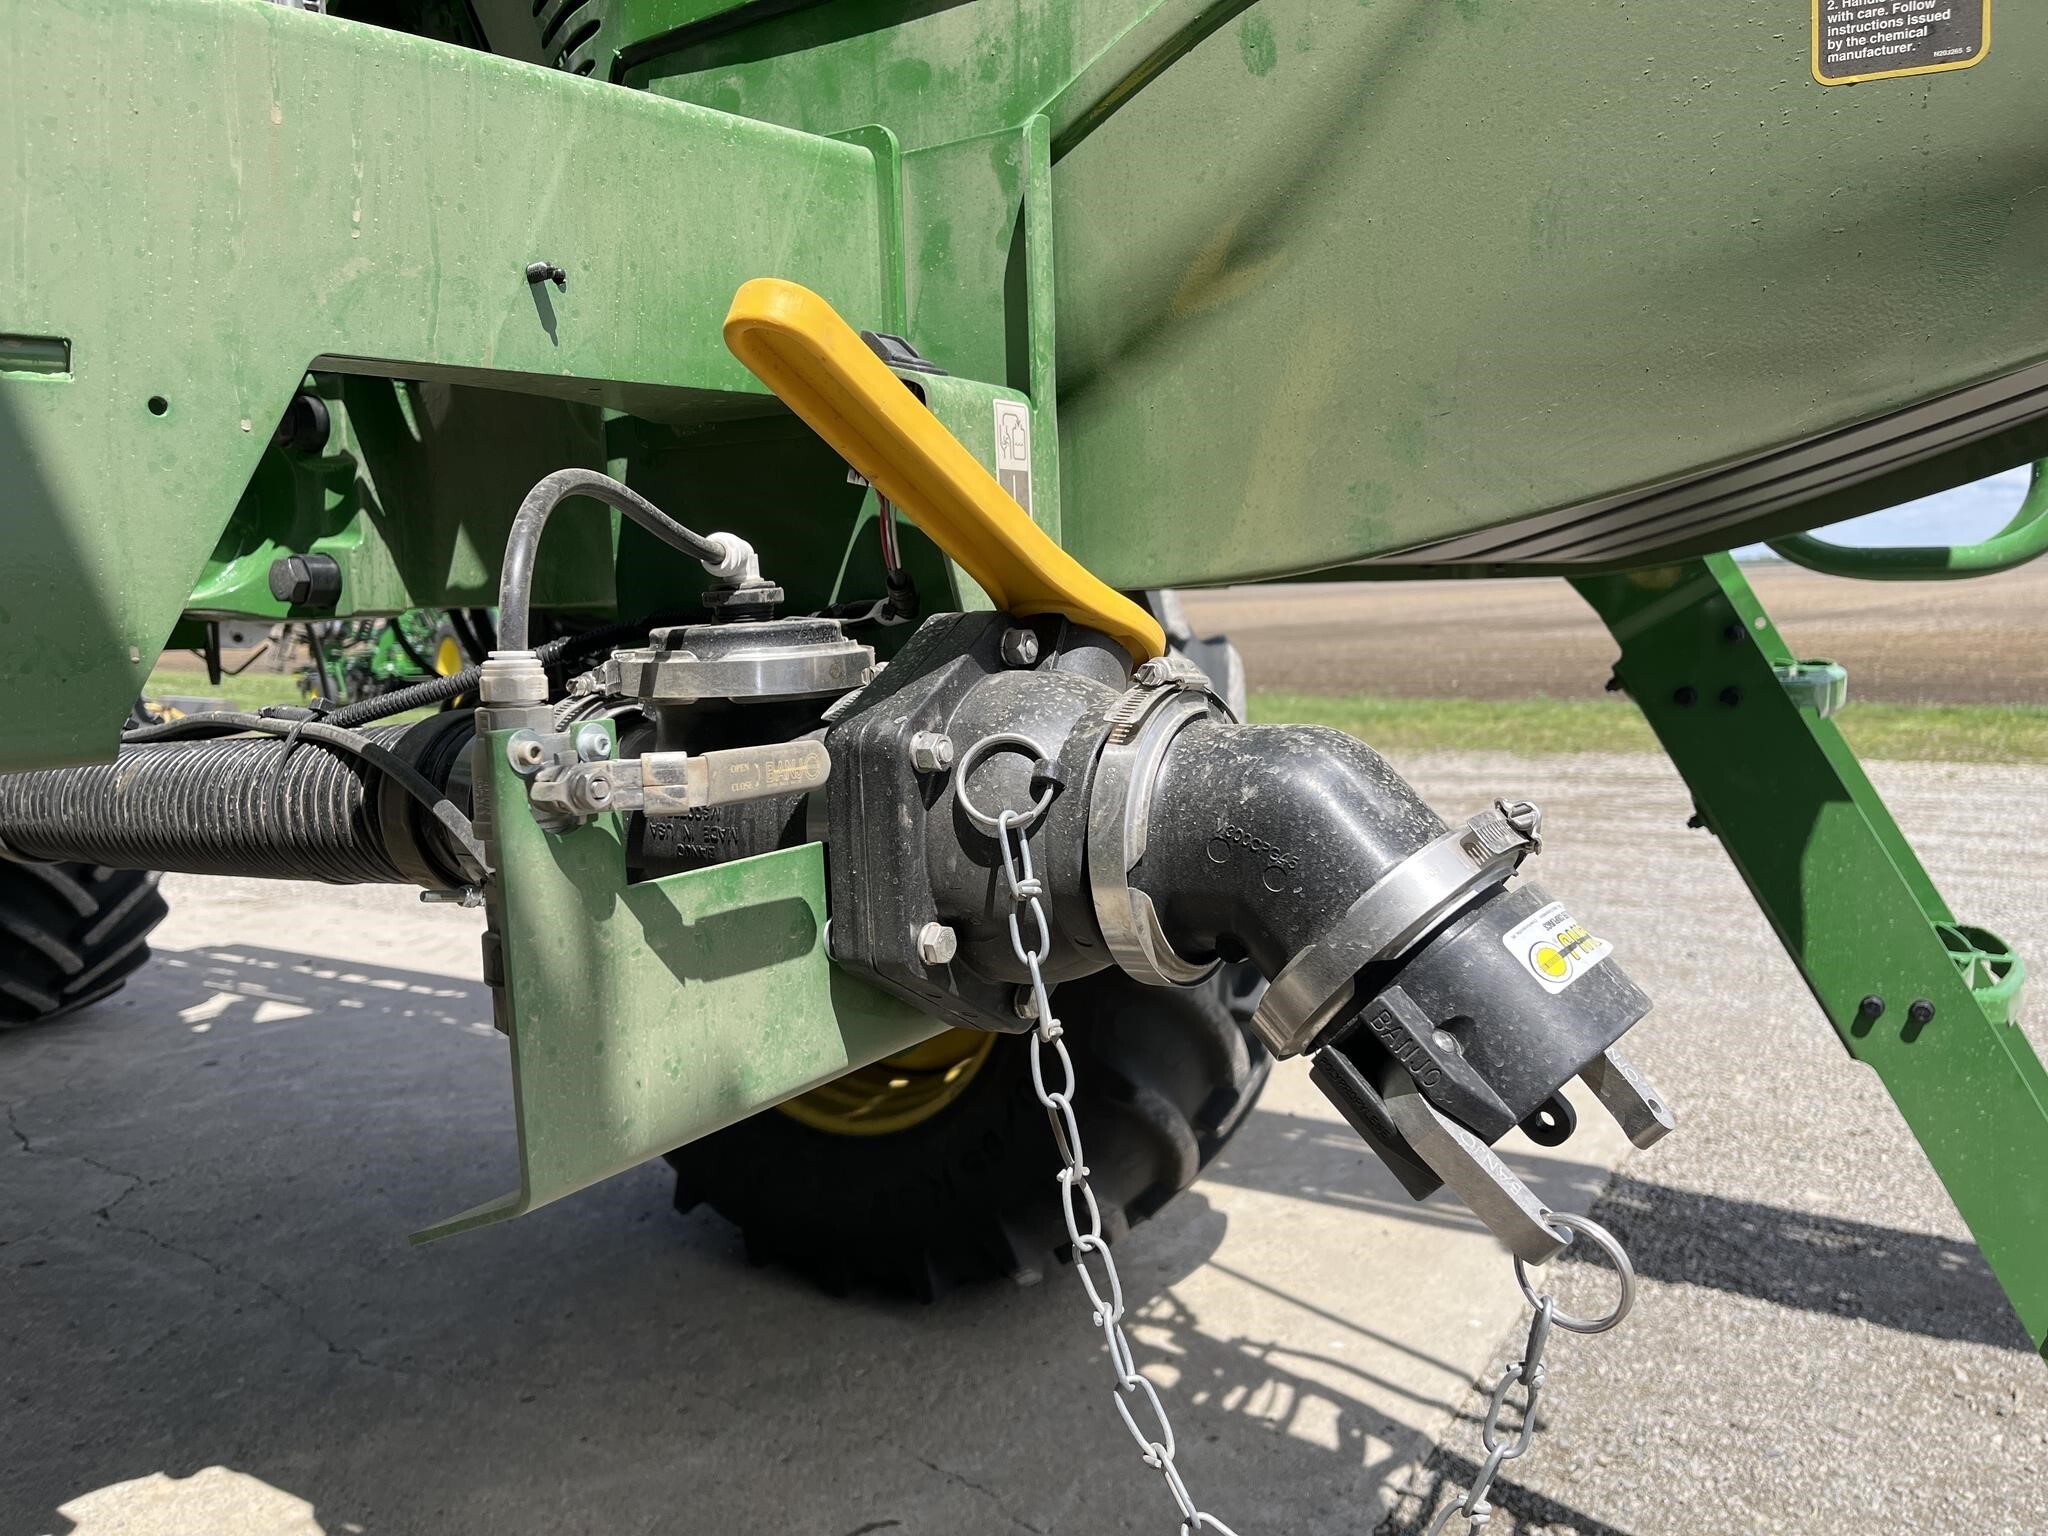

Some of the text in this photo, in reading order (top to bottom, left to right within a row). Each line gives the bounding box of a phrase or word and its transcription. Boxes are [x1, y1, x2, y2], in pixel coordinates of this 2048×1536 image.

[1827, 0, 1838, 10] 2.
[1827, 0, 1936, 24] with care. Follow
[1827, 9, 1951, 37] instructions issued
[1827, 26, 1928, 51] by the chemical
[1827, 43, 1917, 63] manufacturer.
[729, 762, 751, 774] OPEN
[765, 752, 821, 785] BANJO
[731, 780, 754, 792] CLOSE
[649, 821, 739, 845] MADE IN USA
[1369, 1008, 1443, 1089] BANJO
